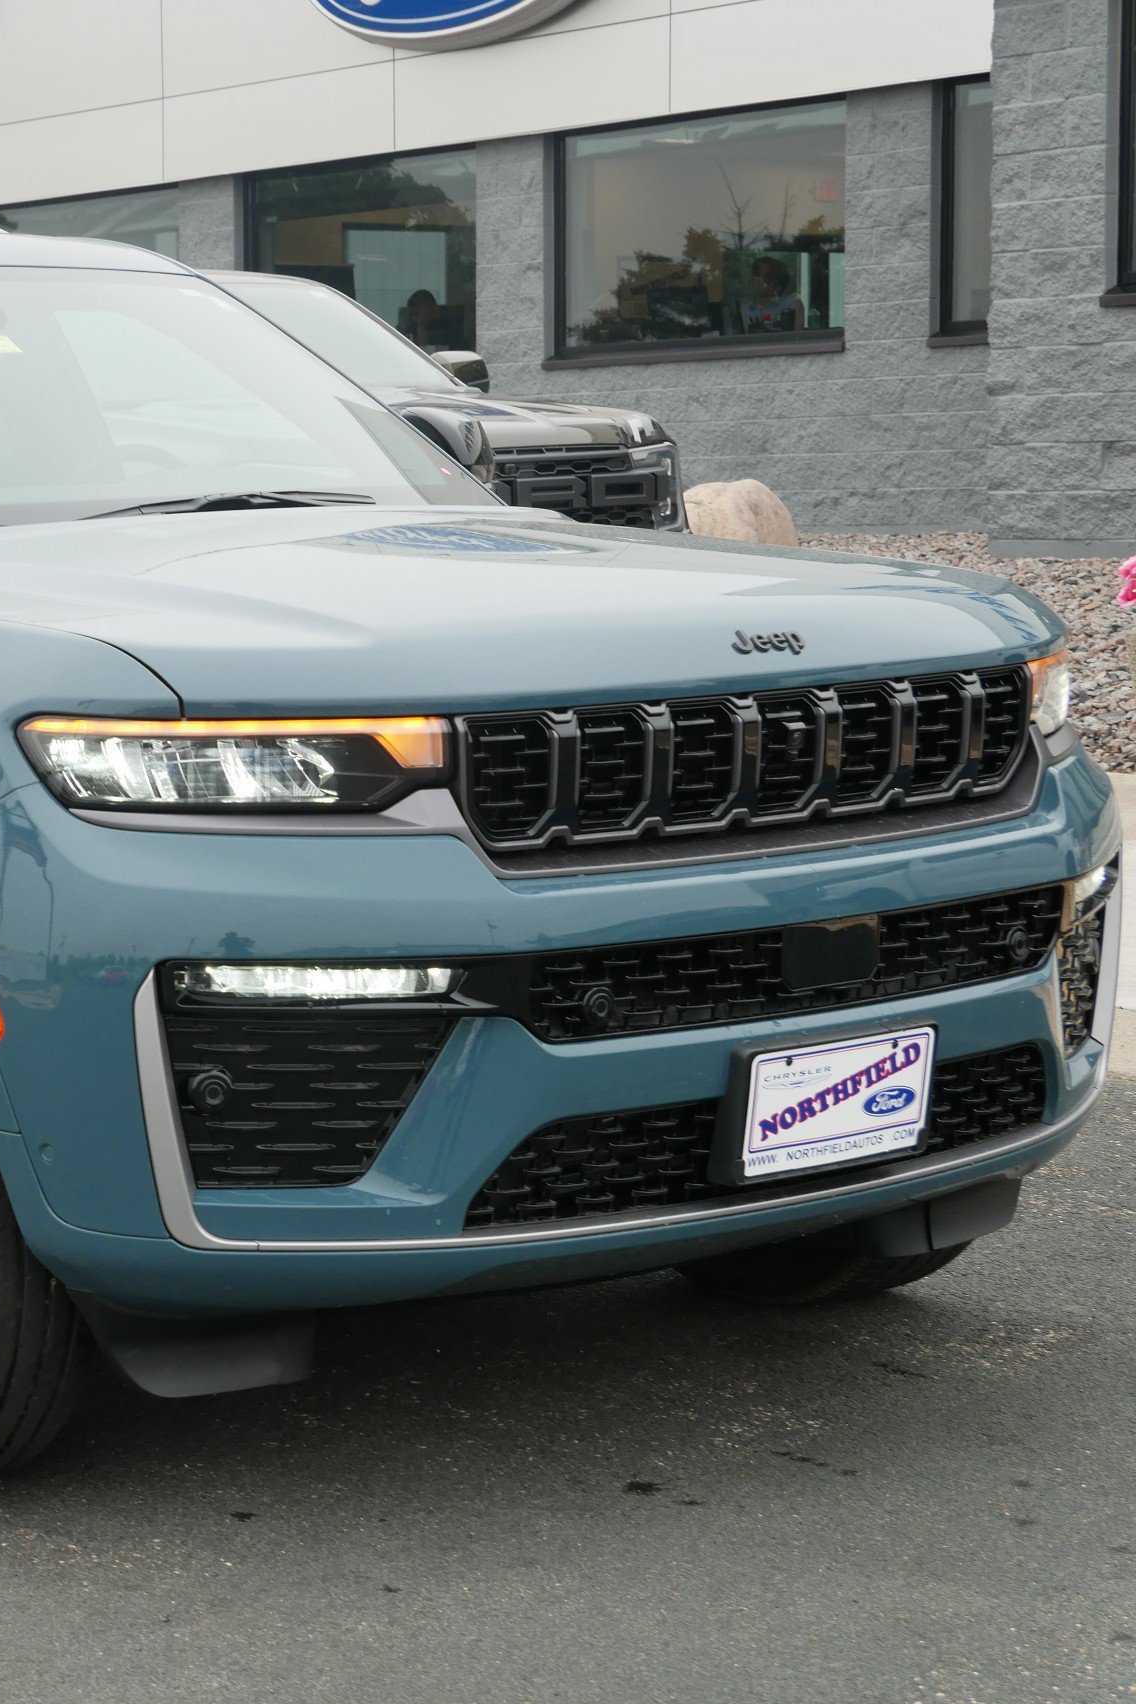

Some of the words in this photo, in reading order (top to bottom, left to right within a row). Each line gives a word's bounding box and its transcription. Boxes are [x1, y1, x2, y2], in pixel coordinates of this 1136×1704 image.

[731, 629, 806, 655] Jeep
[764, 1066, 831, 1082] CHRYSLER
[758, 1041, 921, 1142] NORTHFIELD
[785, 1133, 883, 1161] NORTHFIELDAUTOS
